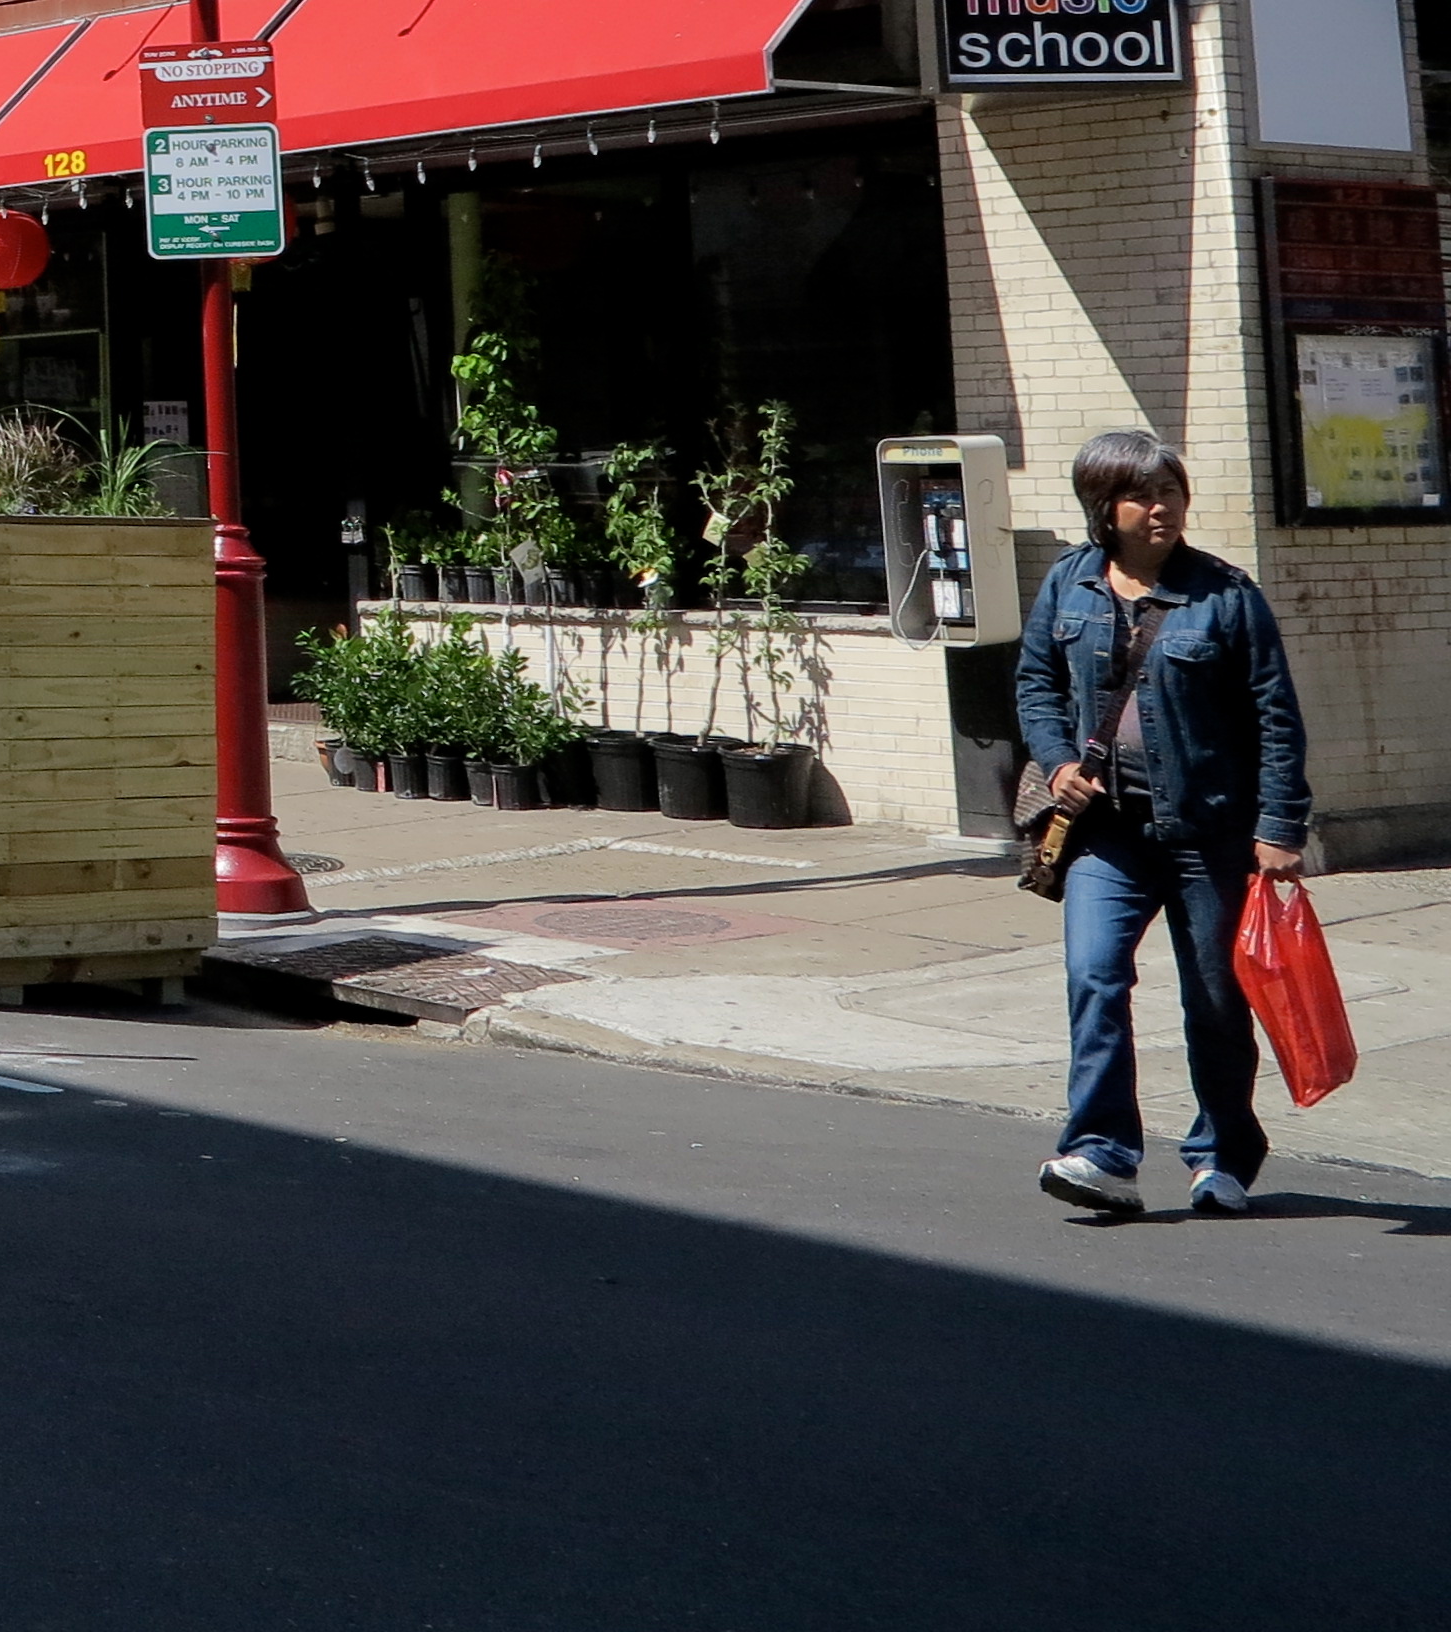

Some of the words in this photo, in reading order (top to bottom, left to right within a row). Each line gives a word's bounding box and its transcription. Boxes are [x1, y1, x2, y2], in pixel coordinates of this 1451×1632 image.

[957, 20, 1166, 68] school
[161, 65, 183, 78] NO
[186, 60, 260, 76] STOPPING
[170, 91, 248, 108] ANYTIME
[155, 138, 167, 153] 2
[172, 139, 208, 151] HOUR
[213, 136, 268, 149] PARKING
[43, 150, 87, 178] 128
[175, 157, 184, 168] 8
[189, 156, 209, 168] AM
[225, 155, 234, 166] 4
[239, 154, 259, 165] PM
[157, 178, 170, 192] 3
[176, 176, 213, 188] HOUR
[217, 174, 272, 187] PARKING
[177, 191, 186, 201] 4
[191, 190, 211, 201] PM
[227, 189, 241, 200] 10
[246, 188, 266, 199] PM
[184, 214, 209, 225] MON
[220, 213, 241, 224] SAT
[901, 446, 944, 457] Phone
